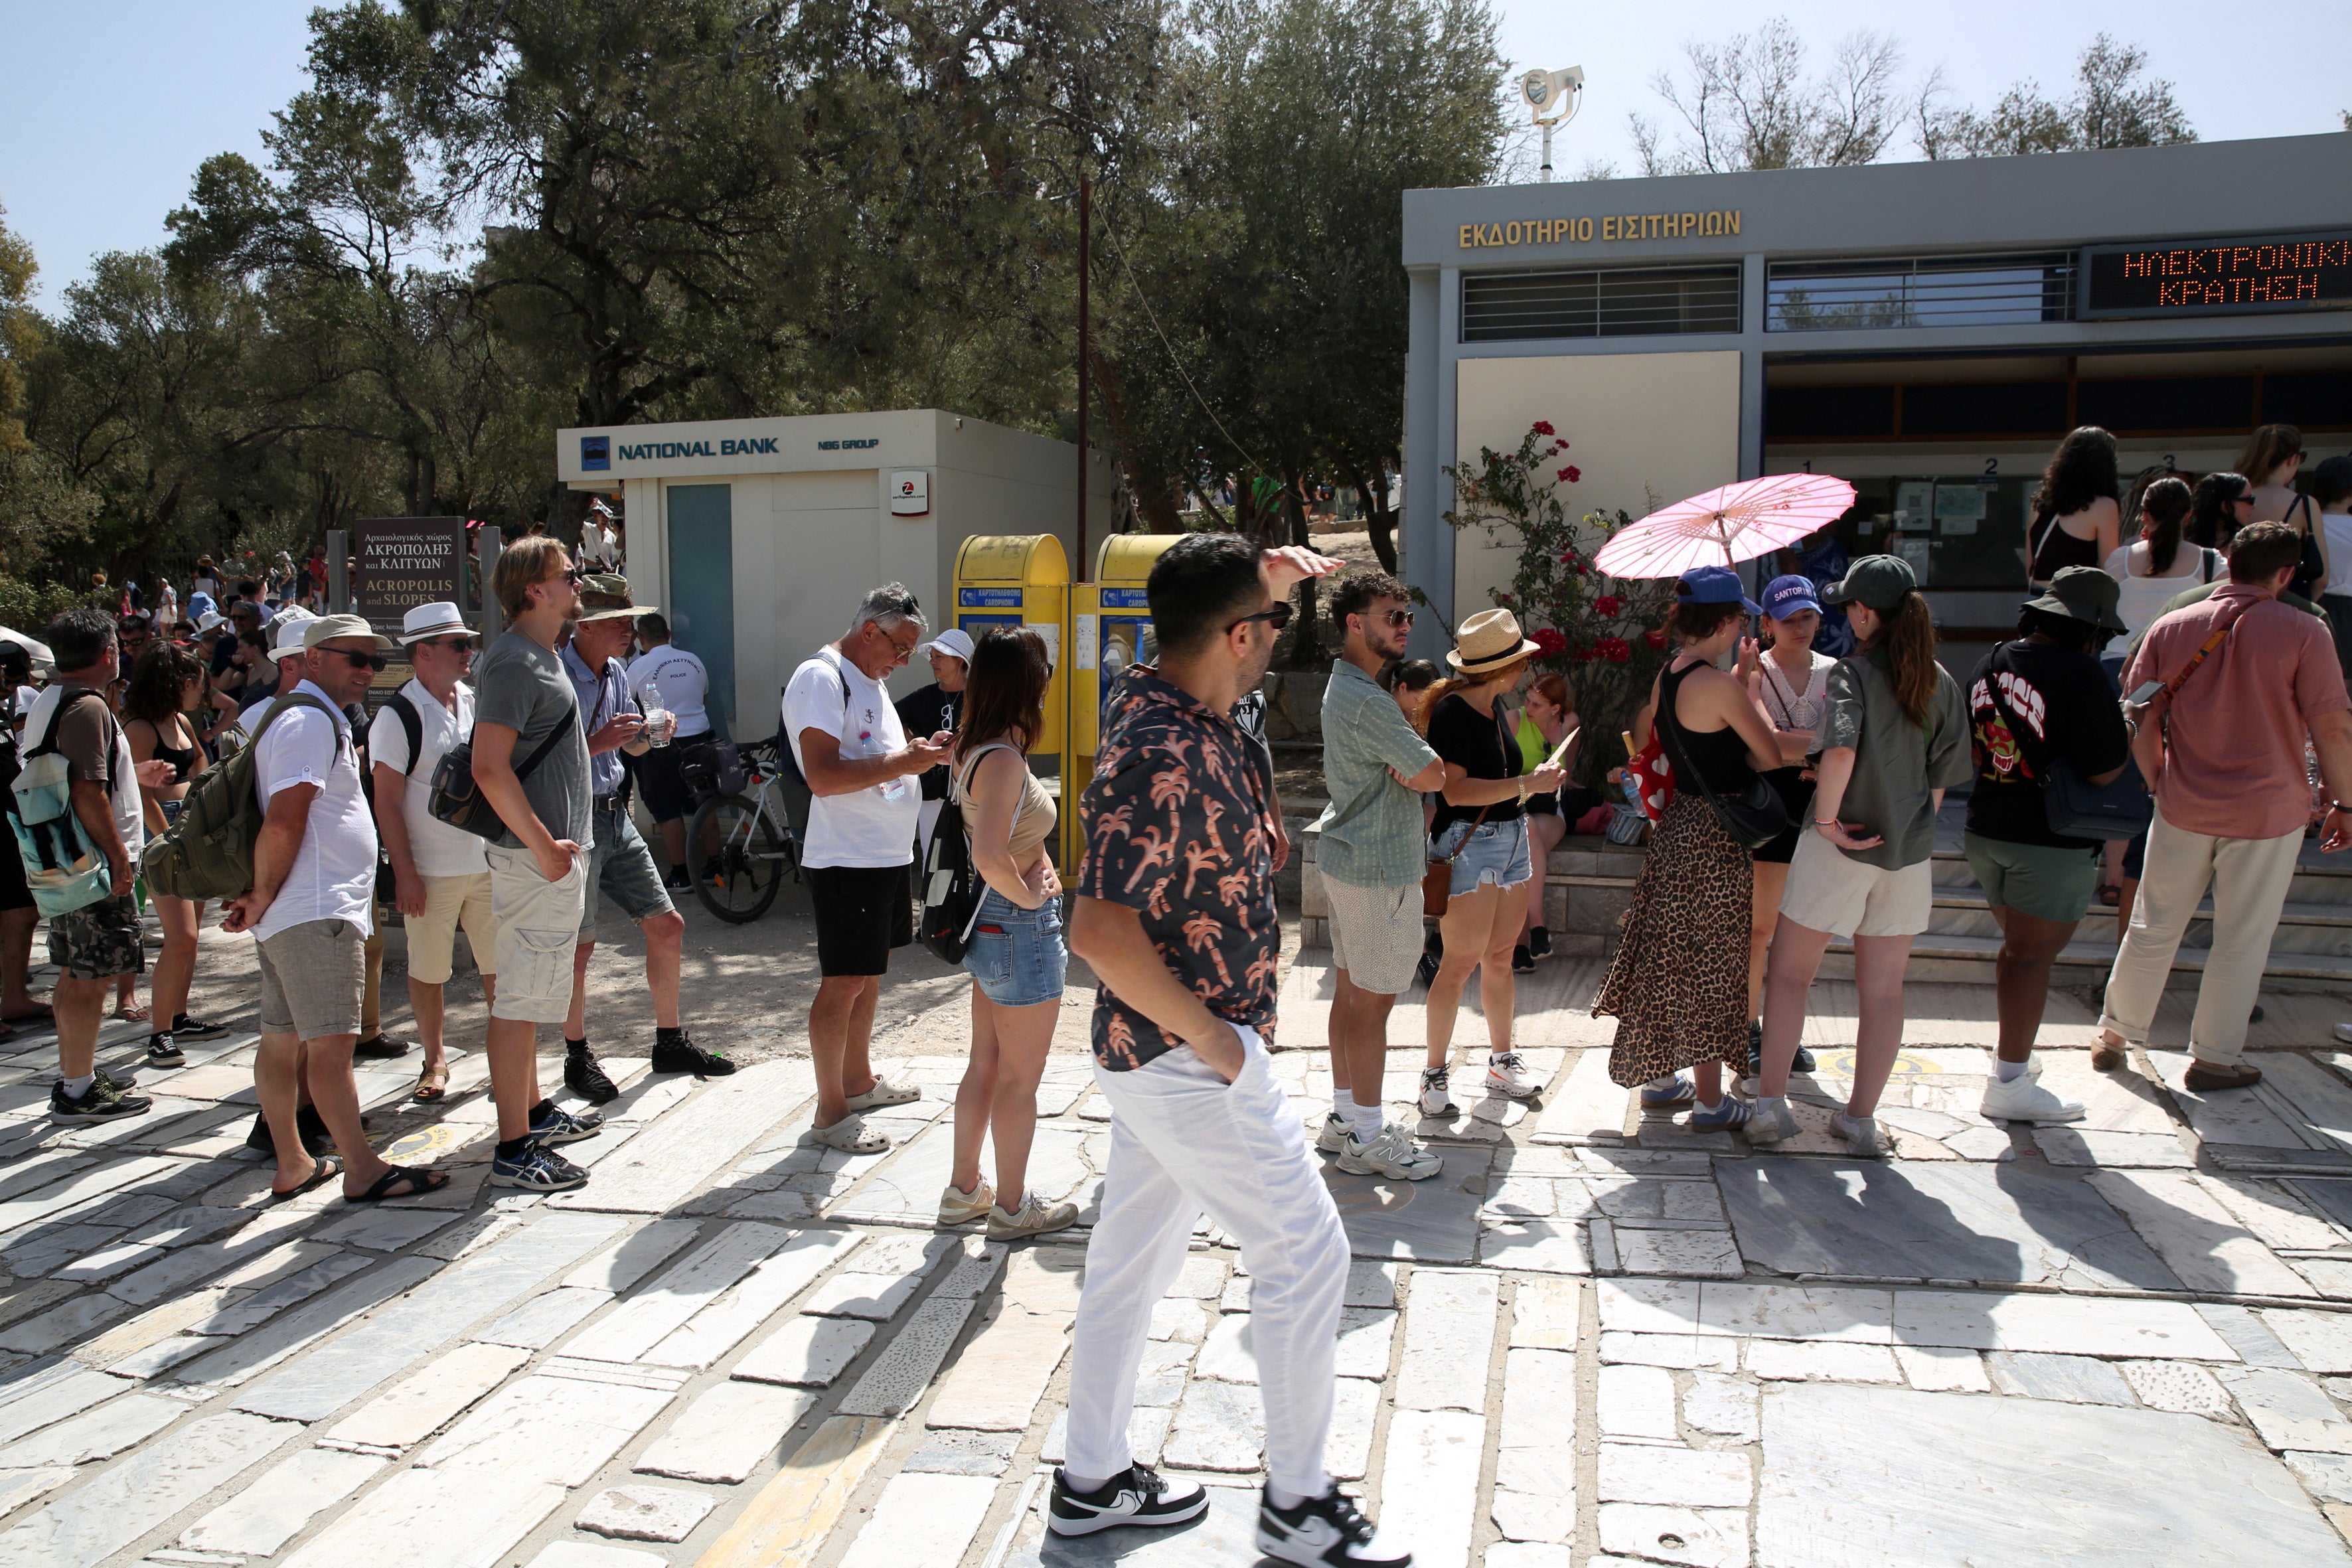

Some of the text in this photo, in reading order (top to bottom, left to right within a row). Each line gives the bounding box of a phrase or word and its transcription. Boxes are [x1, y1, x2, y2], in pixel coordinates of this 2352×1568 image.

[1460, 210, 1741, 248] ΕΚΔΟΤΗΡΙΟ ΕΙΣΙΤΗΡΙΩΝ
[2159, 274, 2318, 306] ΚΡΑΤΗΣΗ
[619, 437, 779, 460] NATIONAL BANK
[818, 439, 879, 451] NBG GROUP
[1985, 458, 1998, 475] 2
[365, 533, 452, 543] Αρχαιολογικός χώρος
[365, 544, 452, 556] ΑΚΡΟΠΟΛΗΣ
[380, 558, 441, 569] ΚΛΙΤΥΩΝ
[366, 580, 453, 591] ACROPOLIS
[384, 593, 435, 605] SLOPES
[1774, 586, 1813, 601] SANTORINI
[653, 659, 672, 680] ΕΛΛΗΝΙΚΗ
